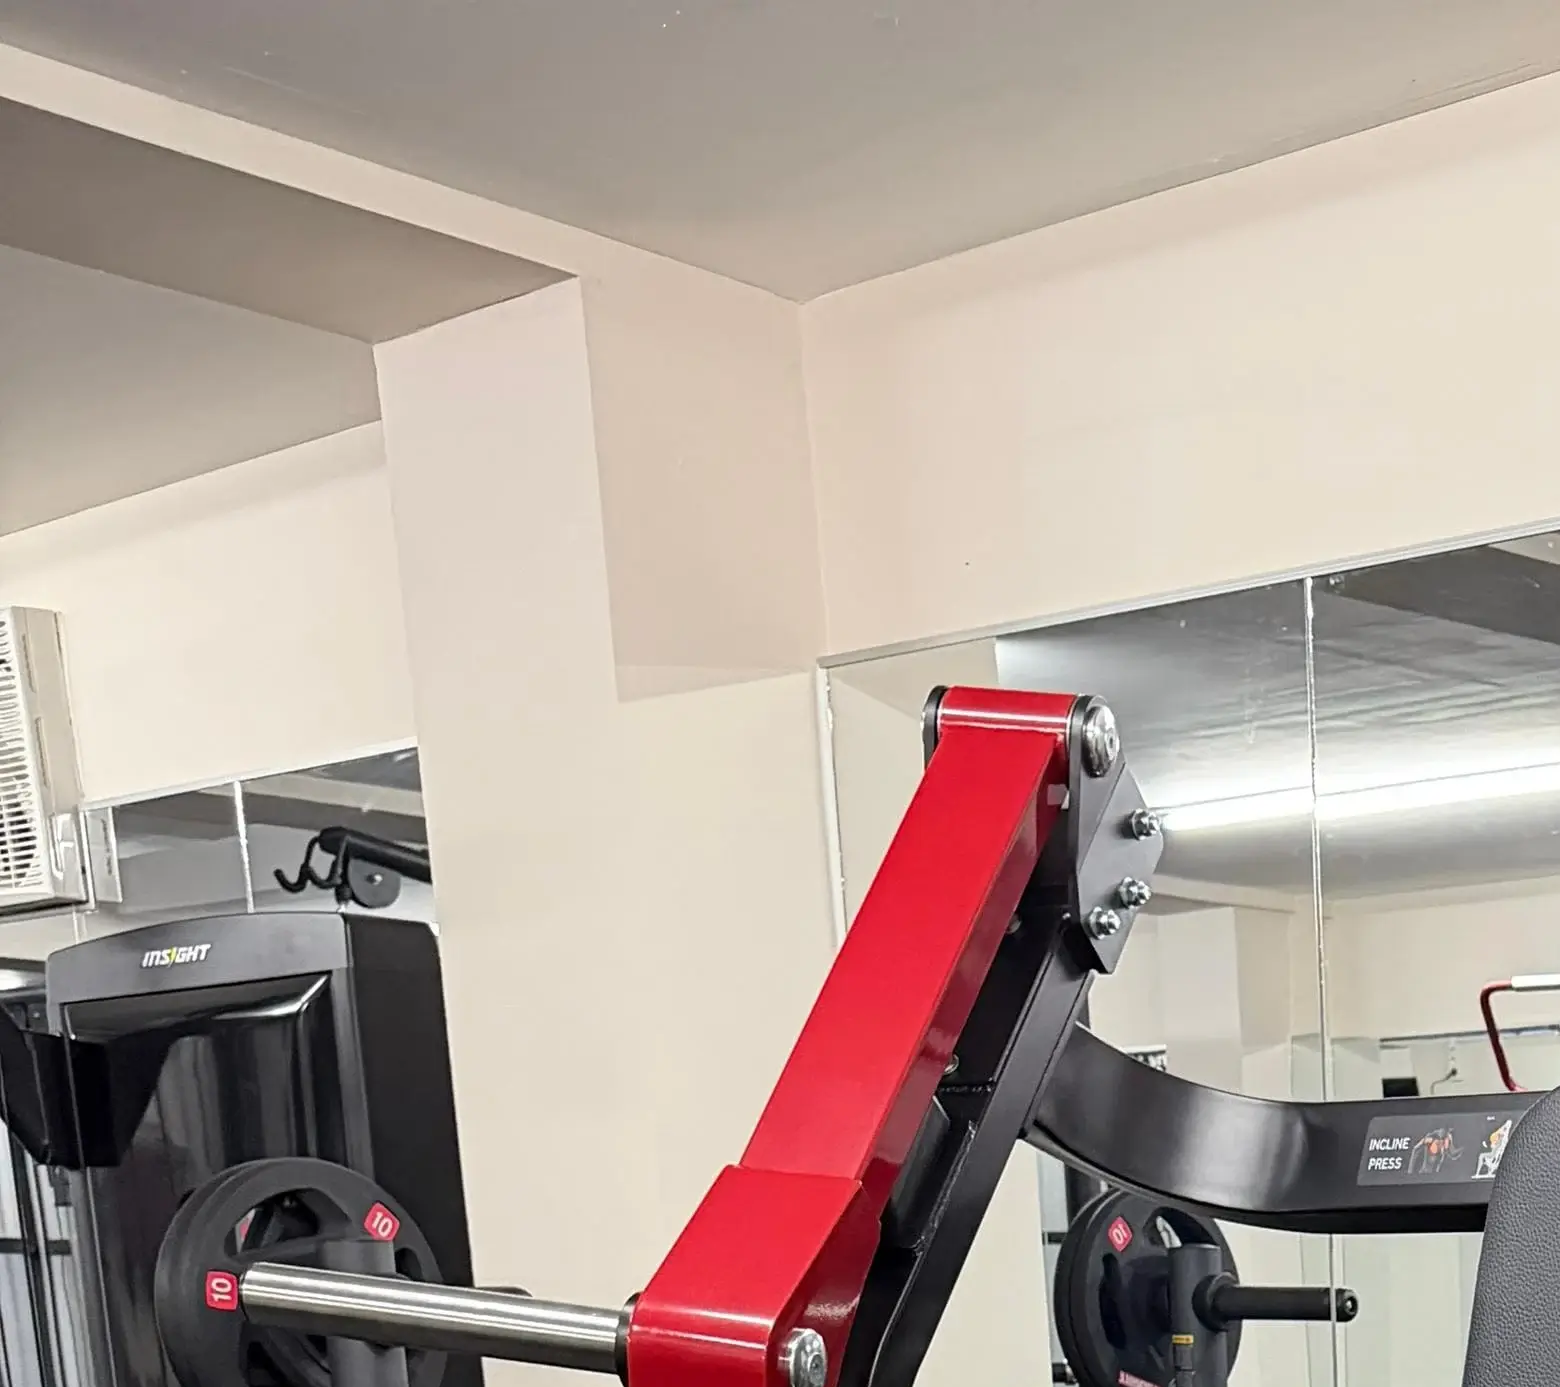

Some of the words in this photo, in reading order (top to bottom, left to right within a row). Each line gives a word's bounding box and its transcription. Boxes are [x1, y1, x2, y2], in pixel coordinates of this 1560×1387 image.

[142, 943, 212, 968] INSIGHT
[1369, 1137, 1411, 1151] INCLINE
[1368, 1157, 1403, 1170] PRESS
[371, 1211, 393, 1238] 10
[211, 1277, 232, 1302] 10
